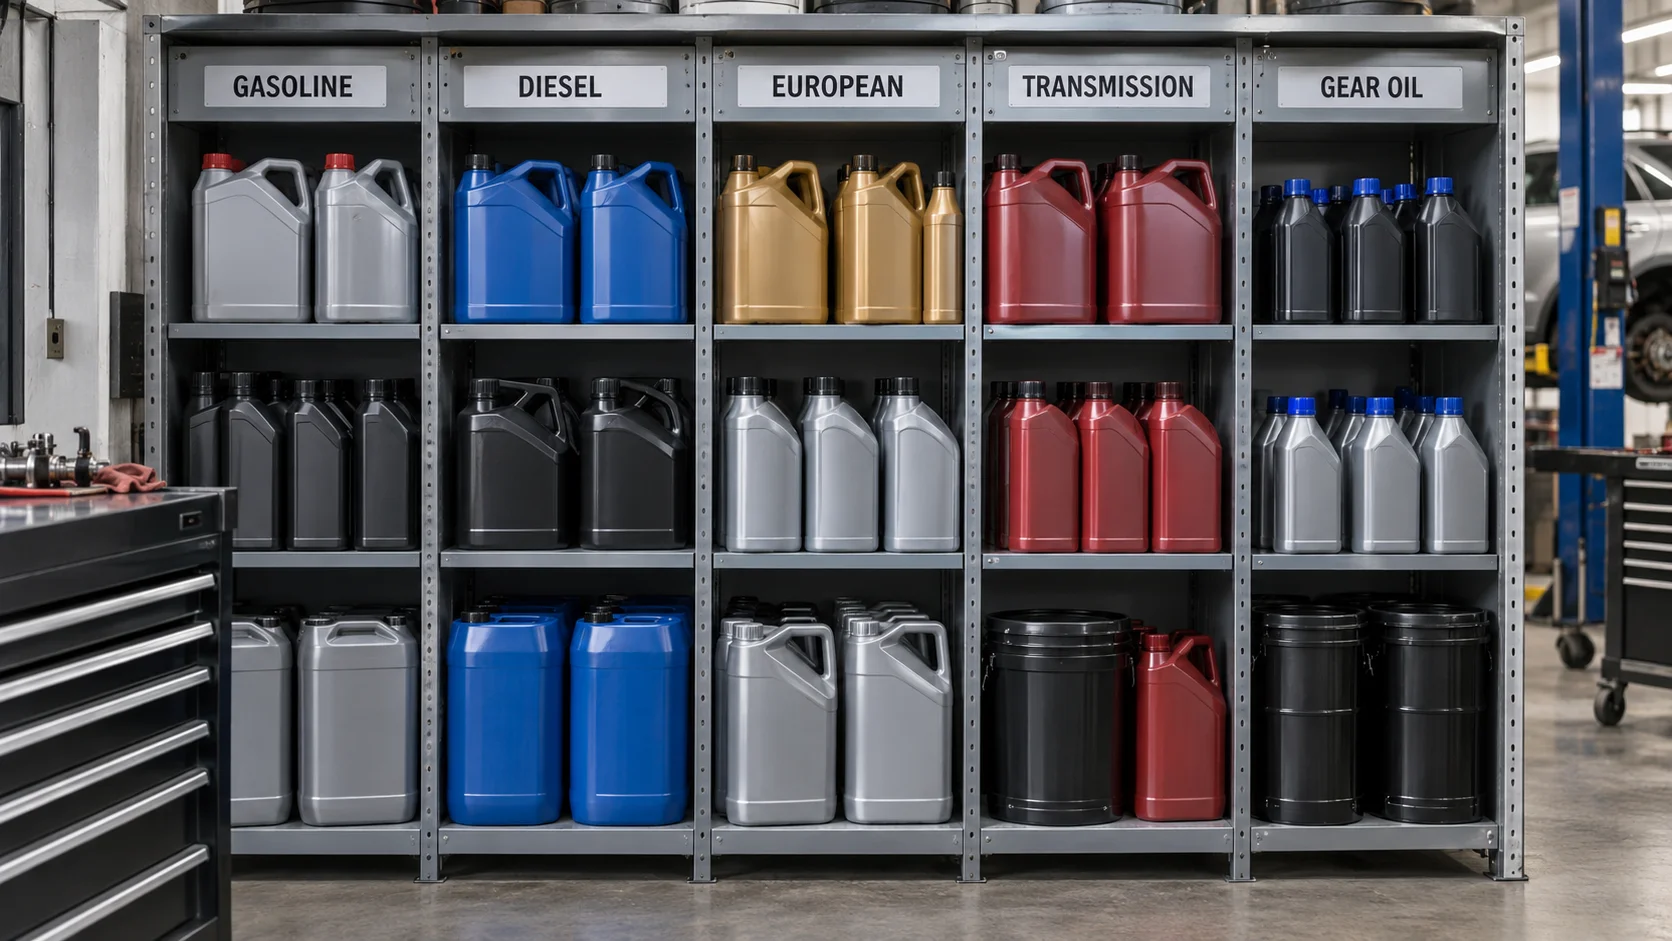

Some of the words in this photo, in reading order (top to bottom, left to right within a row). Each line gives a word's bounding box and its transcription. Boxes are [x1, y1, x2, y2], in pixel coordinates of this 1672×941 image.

[232, 74, 353, 99] GASOLINE
[519, 74, 602, 98] DIESEL
[772, 74, 903, 98] EUROPEAN
[1022, 74, 1194, 98] TRANSMISSION
[1320, 75, 1381, 99] GEAR
[1387, 75, 1424, 99] OIL
